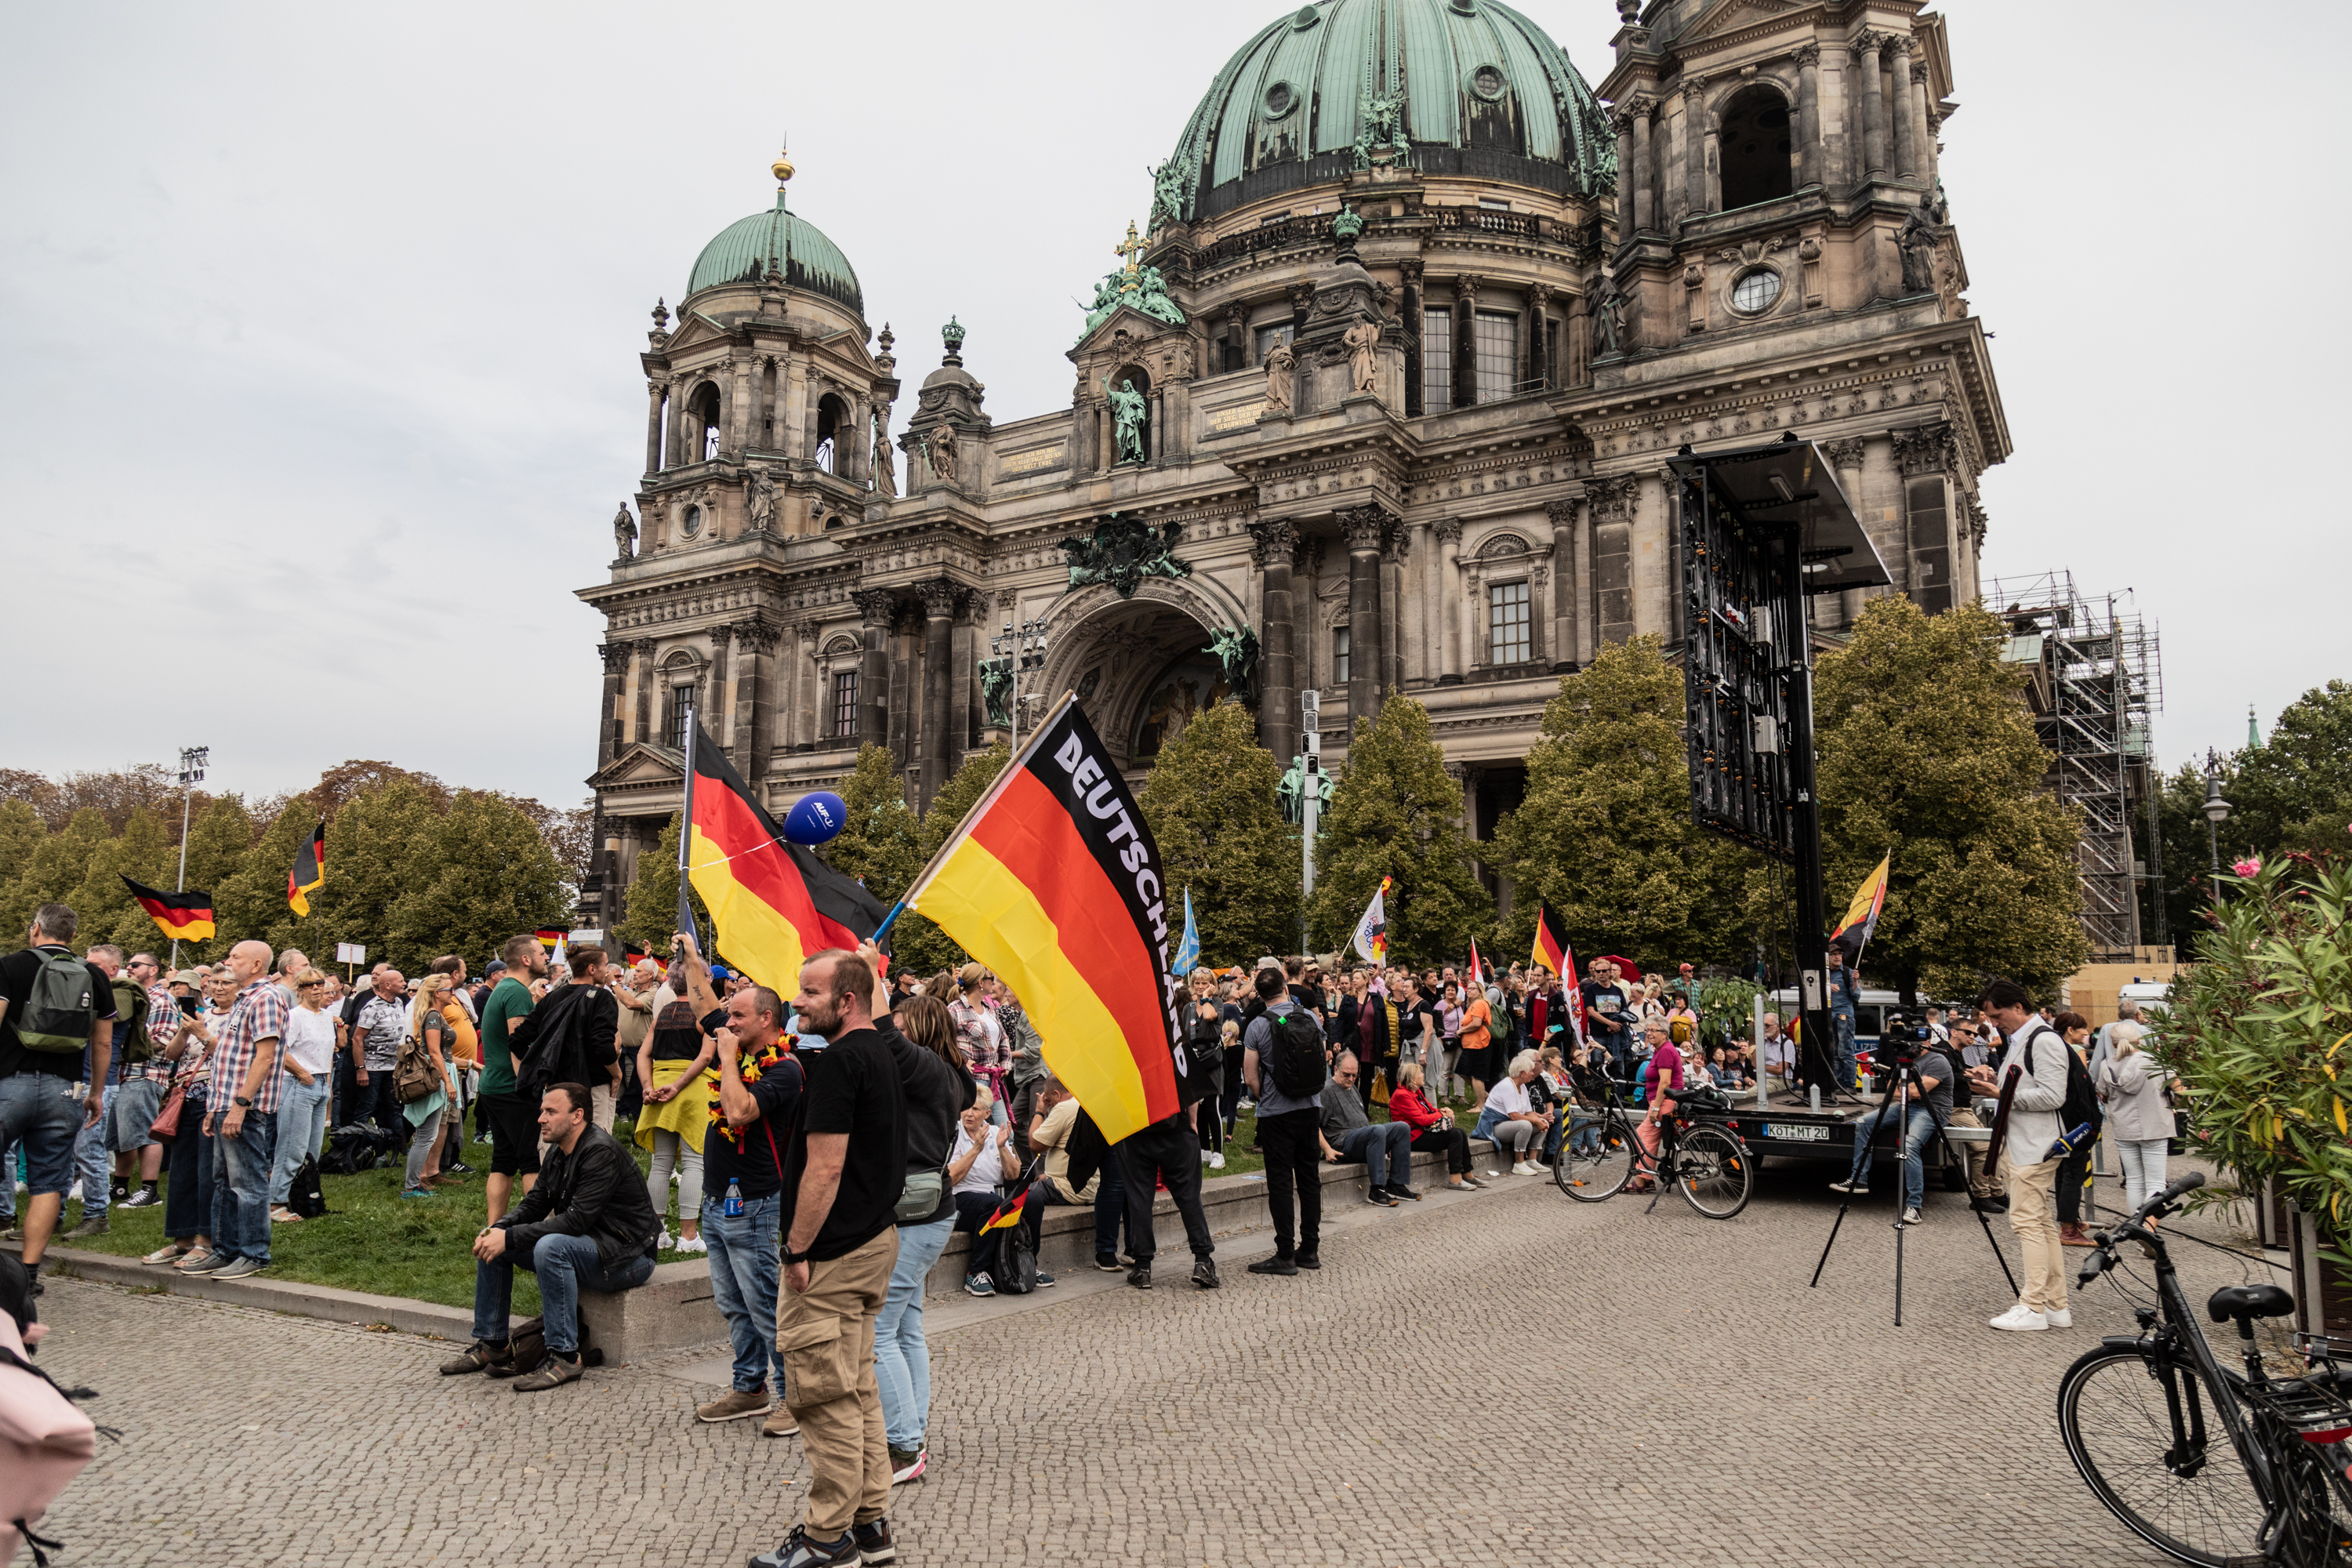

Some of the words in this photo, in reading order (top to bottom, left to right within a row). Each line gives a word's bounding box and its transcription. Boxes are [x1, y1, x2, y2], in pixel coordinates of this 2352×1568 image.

[1217, 408, 1236, 417] UNSER
[1238, 403, 1261, 413] GLAUBE
[1053, 729, 1188, 1078] DEUTSCHLAND
[1797, 1127, 1811, 1138] MT
[1814, 1127, 1828, 1138] 20
